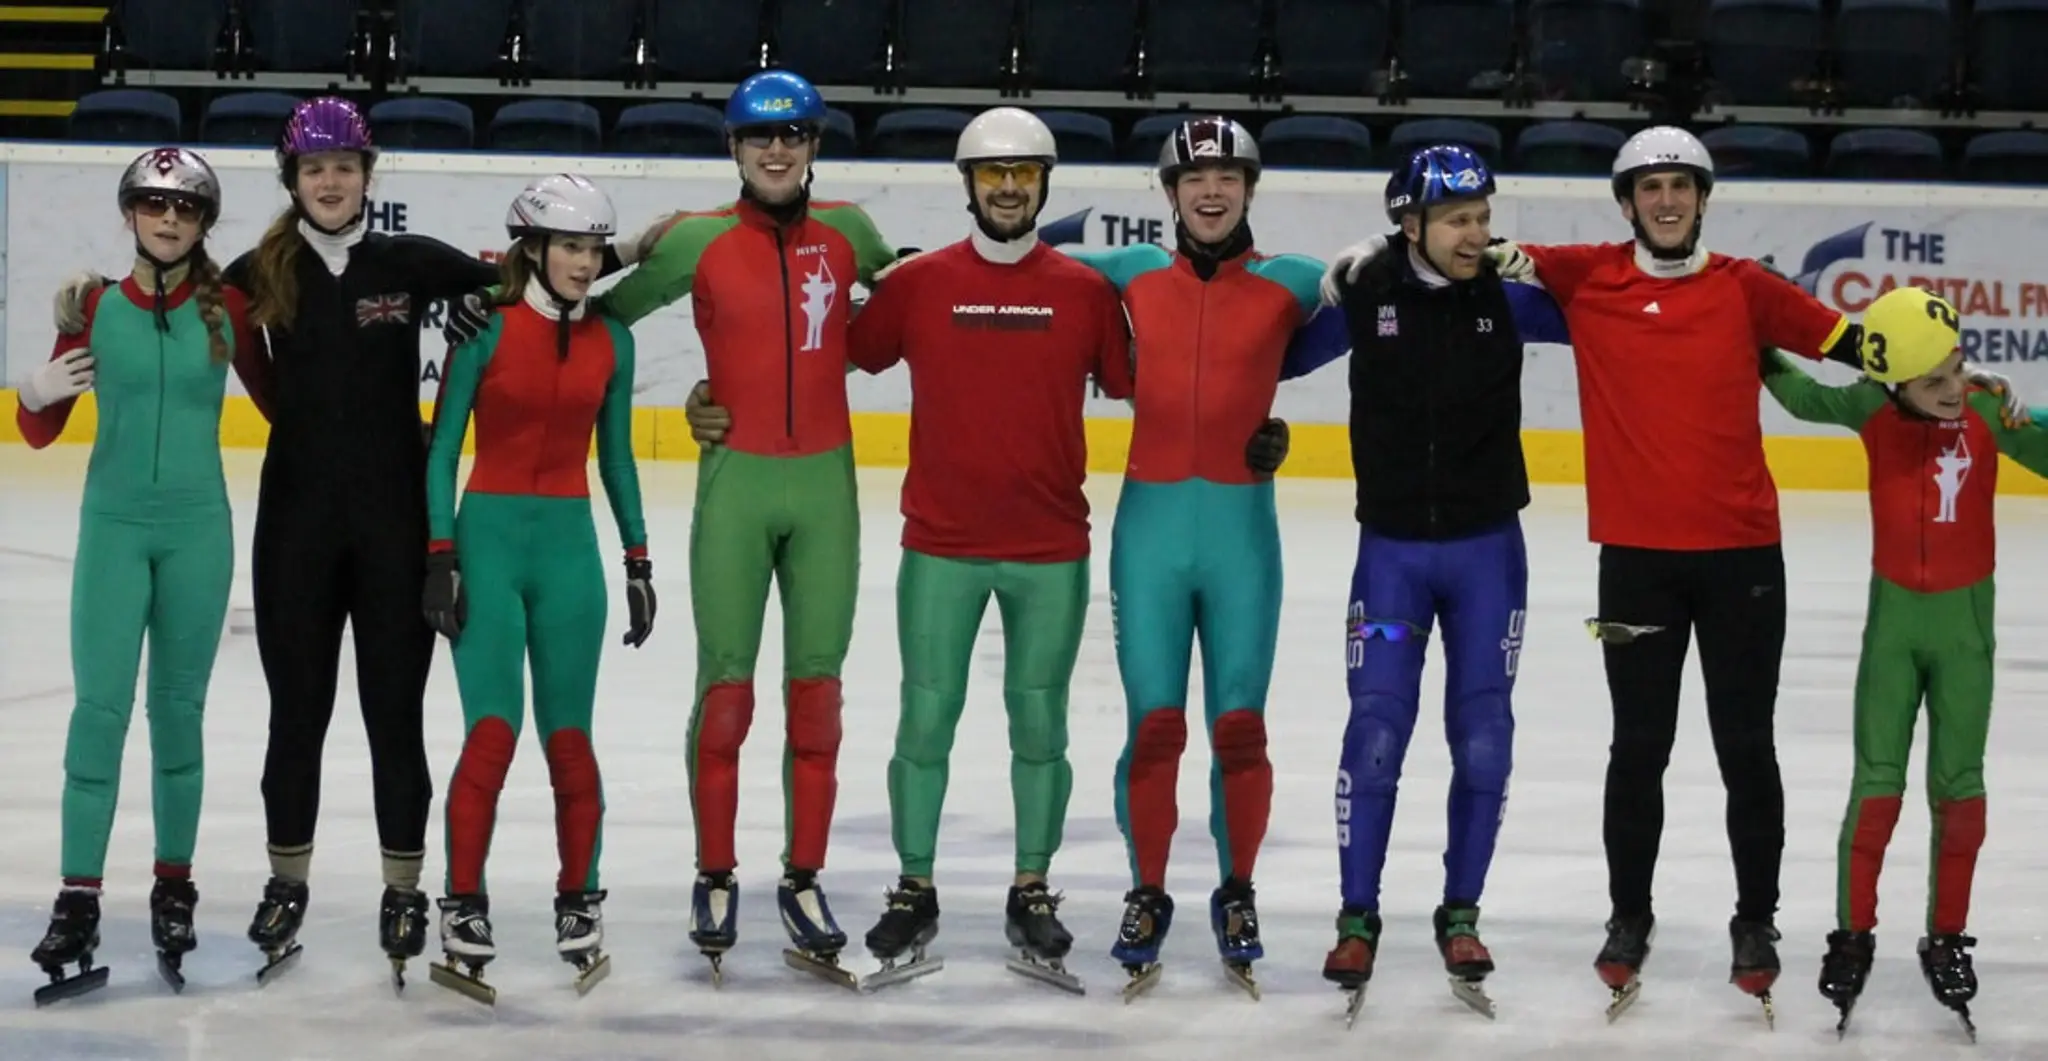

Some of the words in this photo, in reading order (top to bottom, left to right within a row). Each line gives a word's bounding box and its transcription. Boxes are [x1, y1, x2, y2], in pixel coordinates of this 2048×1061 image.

[366, 201, 407, 232] HE
[1101, 213, 1163, 247] THE
[1881, 228, 1944, 264] THE
[953, 304, 995, 314] UNDER
[999, 305, 1053, 316] ARMOUR
[1476, 317, 1493, 333] 33
[1960, 327, 2048, 364] RENA
